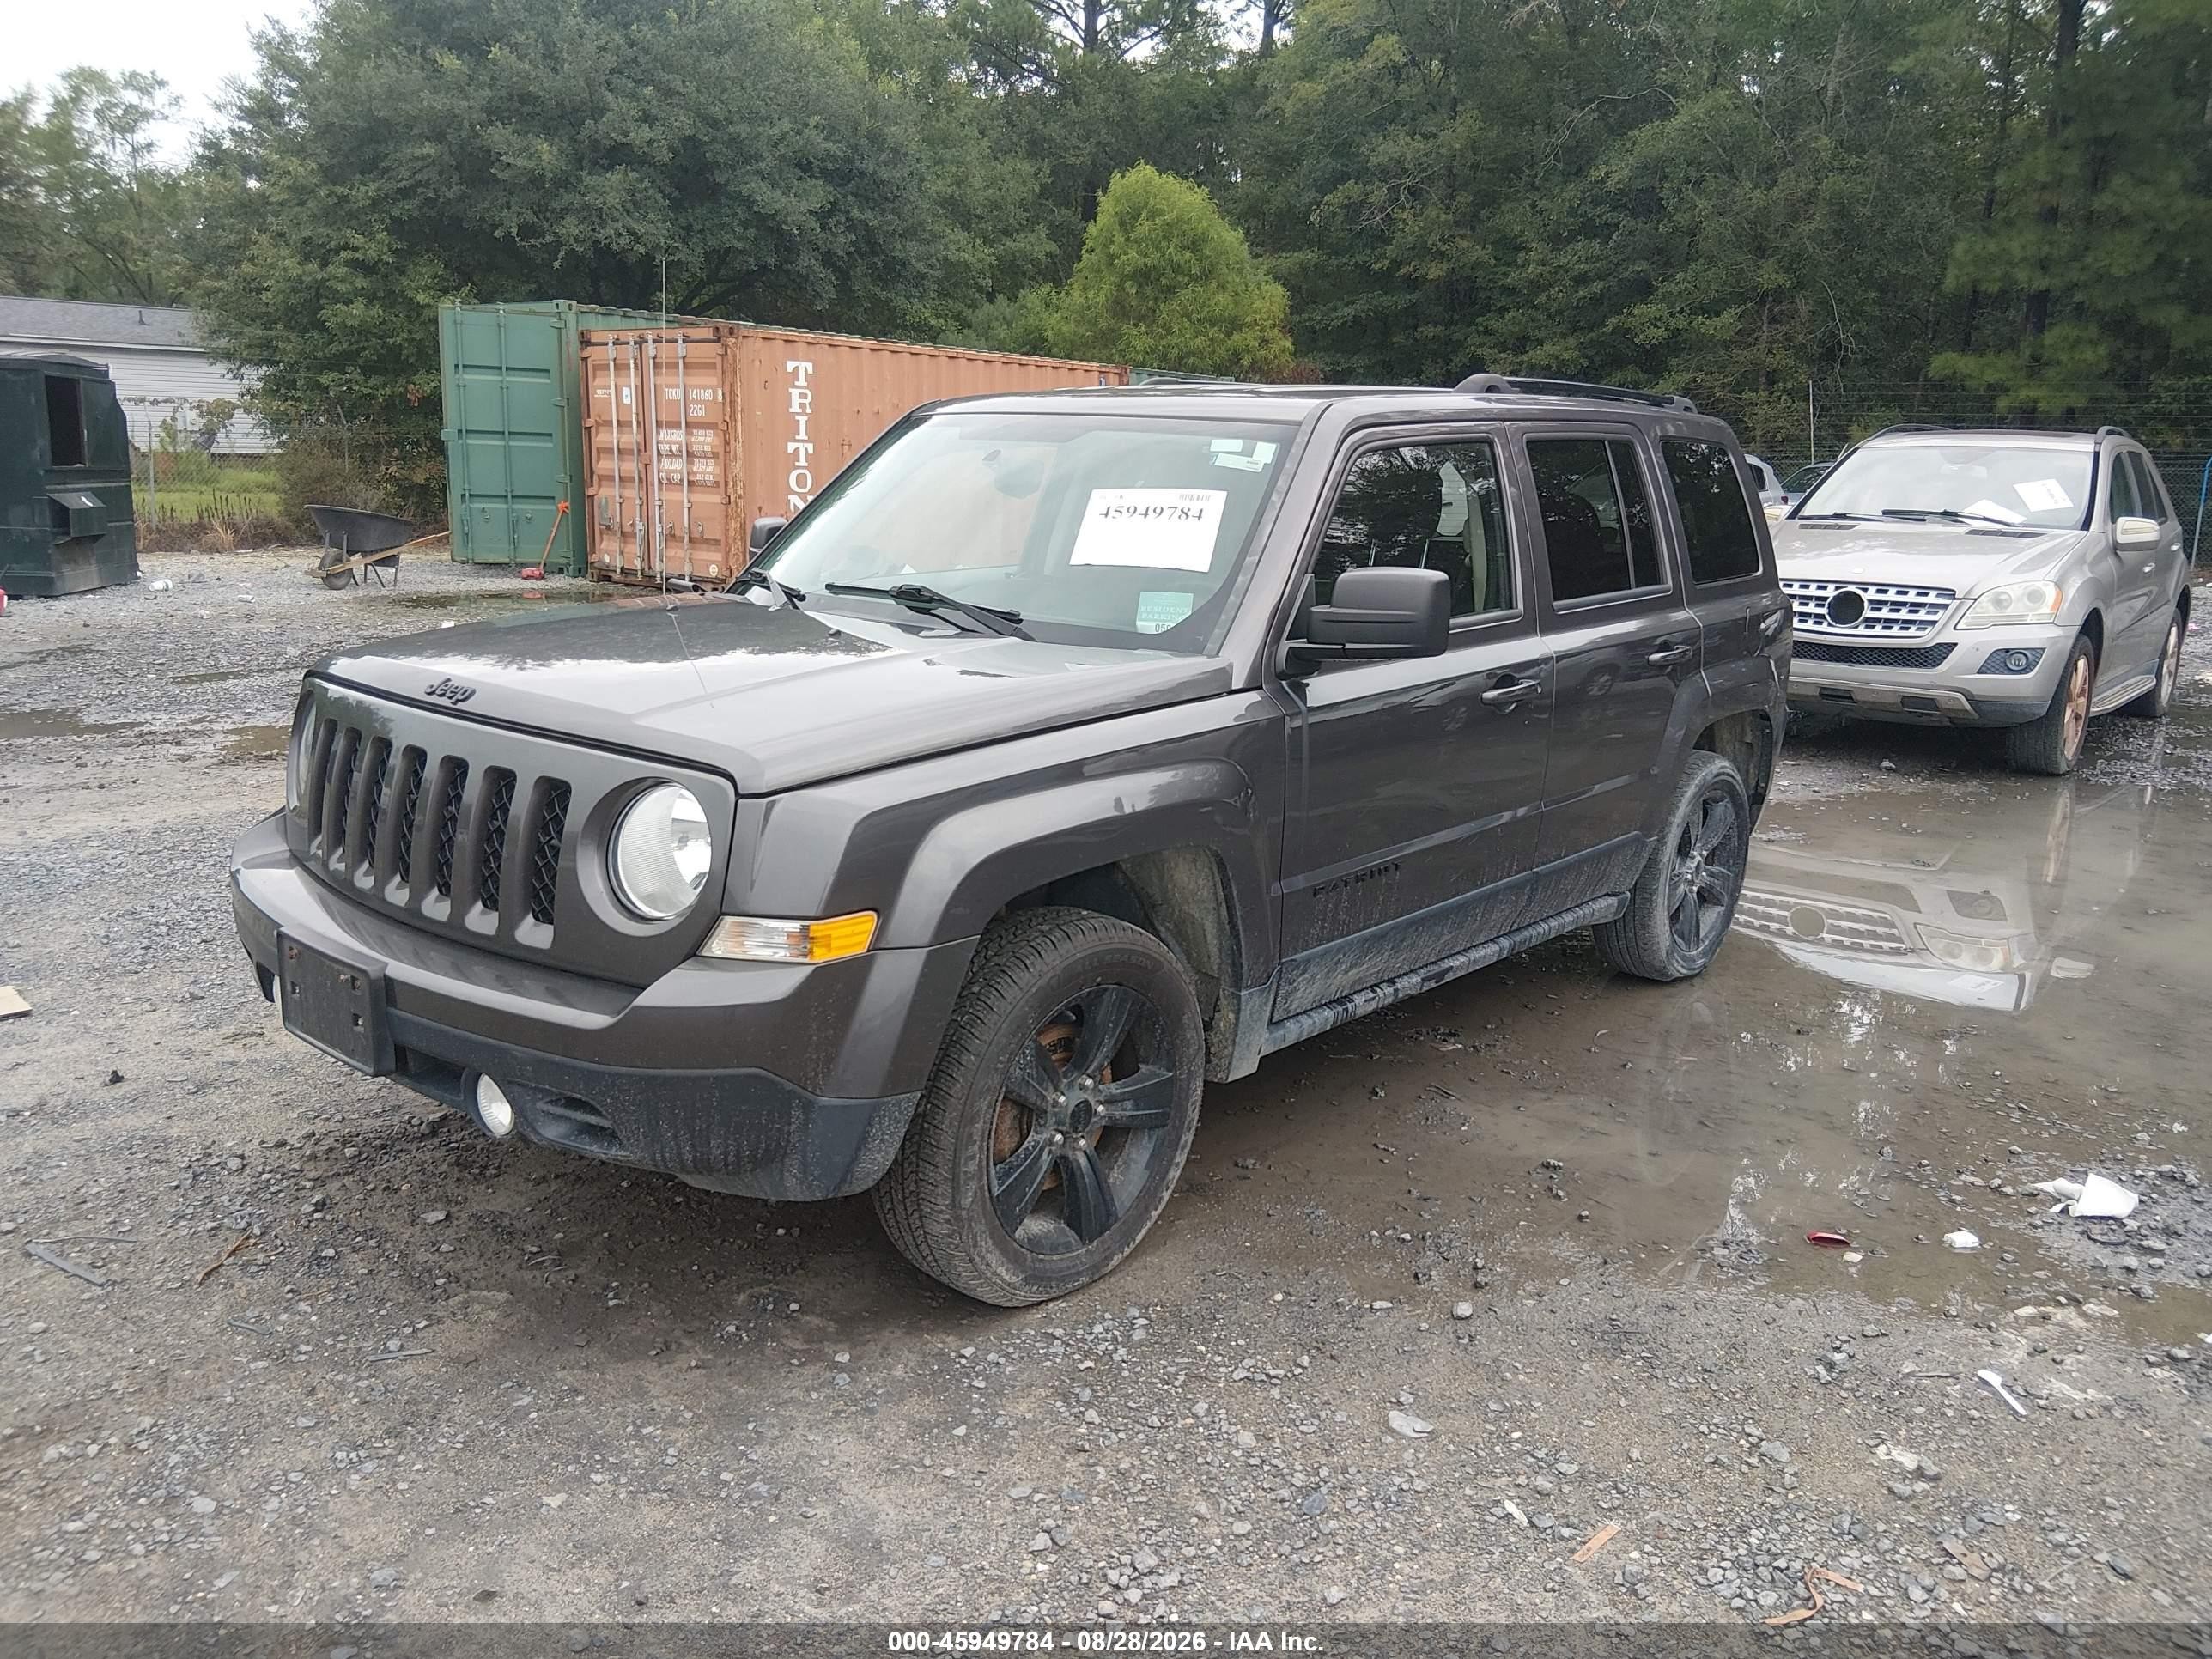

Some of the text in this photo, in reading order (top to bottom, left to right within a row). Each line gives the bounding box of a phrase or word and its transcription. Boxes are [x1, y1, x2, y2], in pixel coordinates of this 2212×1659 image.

[665, 387, 681, 400] TCKU
[689, 388, 714, 401] 141860
[1099, 505, 1204, 521] 45949784
[424, 677, 477, 706] Jeep
